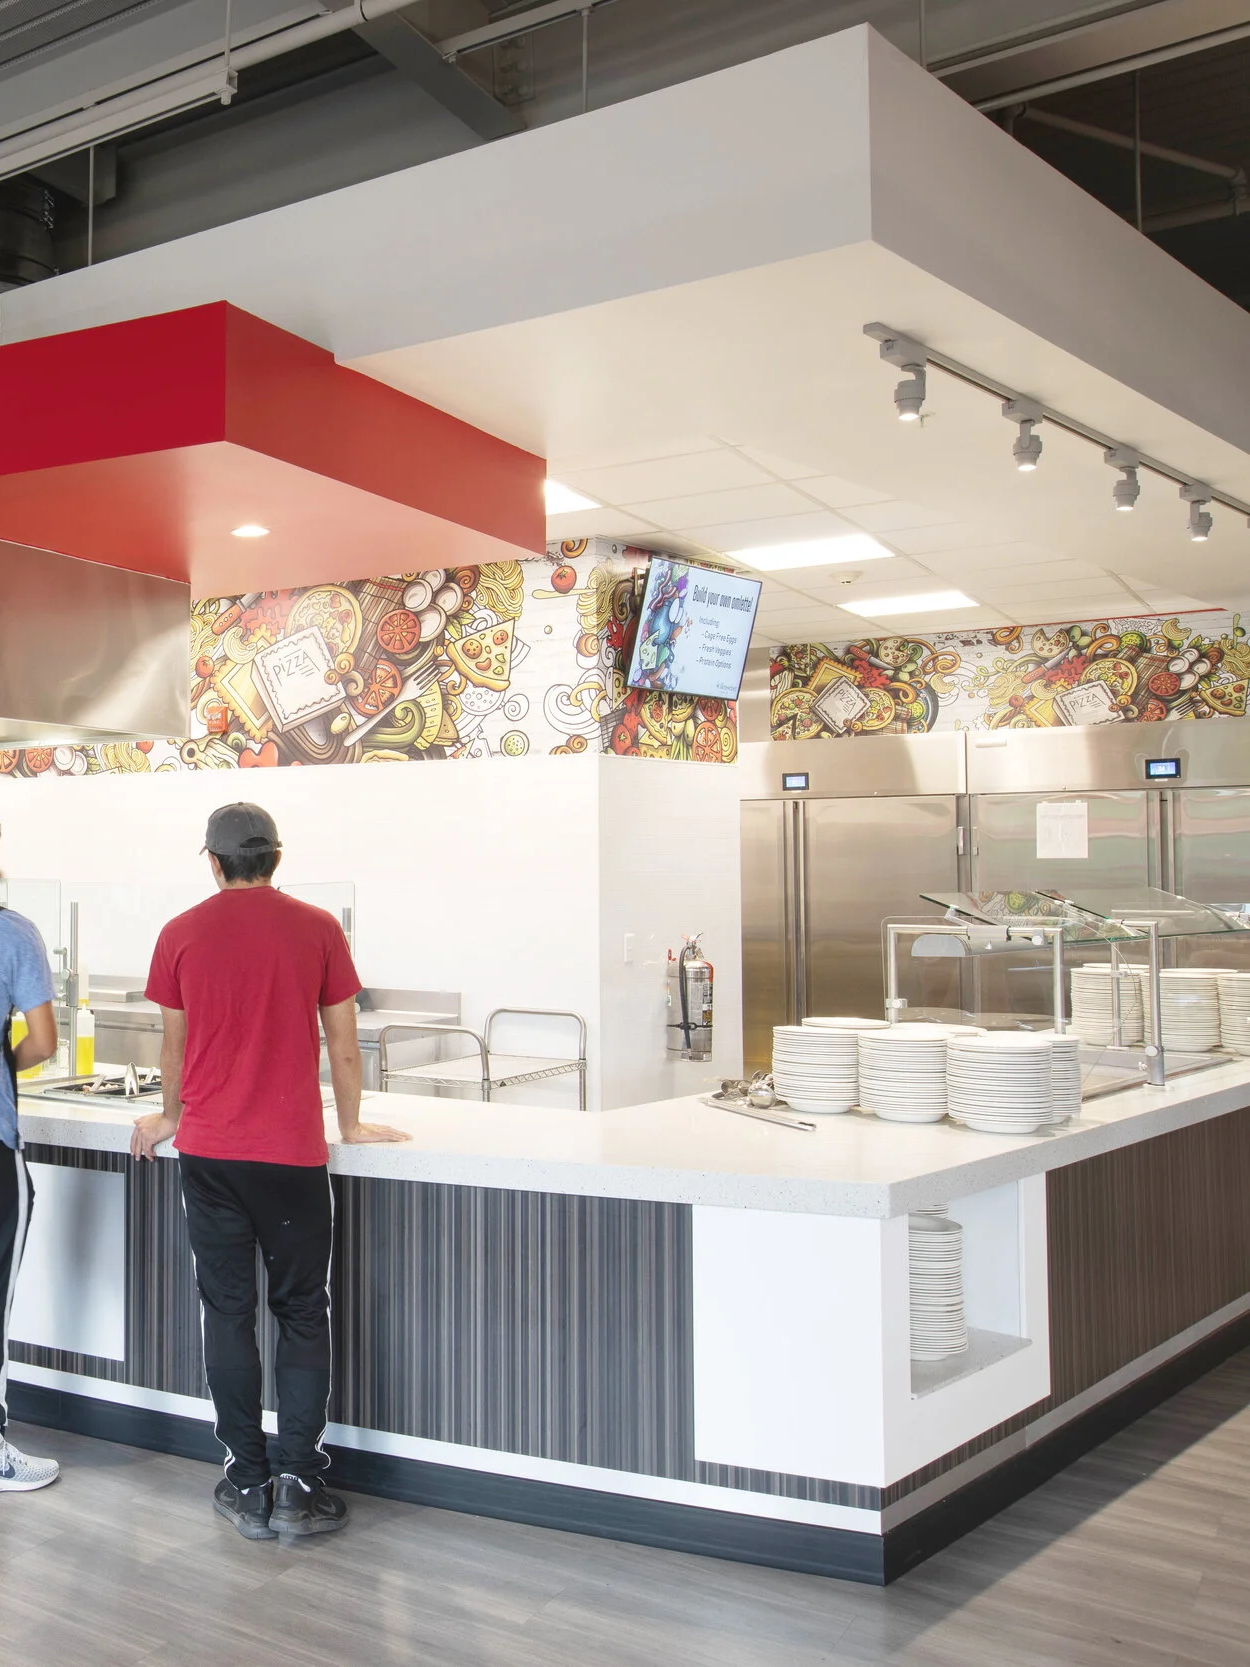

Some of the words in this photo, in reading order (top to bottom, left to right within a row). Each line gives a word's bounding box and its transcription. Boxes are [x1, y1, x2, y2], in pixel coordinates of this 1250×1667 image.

[692, 585, 709, 603] Build
[707, 592, 720, 608] your
[720, 595, 732, 608] own
[705, 630, 716, 641] Cage
[716, 632, 726, 641] Free
[726, 634, 737, 644] Eggs
[702, 643, 715, 653] Fresh
[715, 646, 732, 656] Veggies
